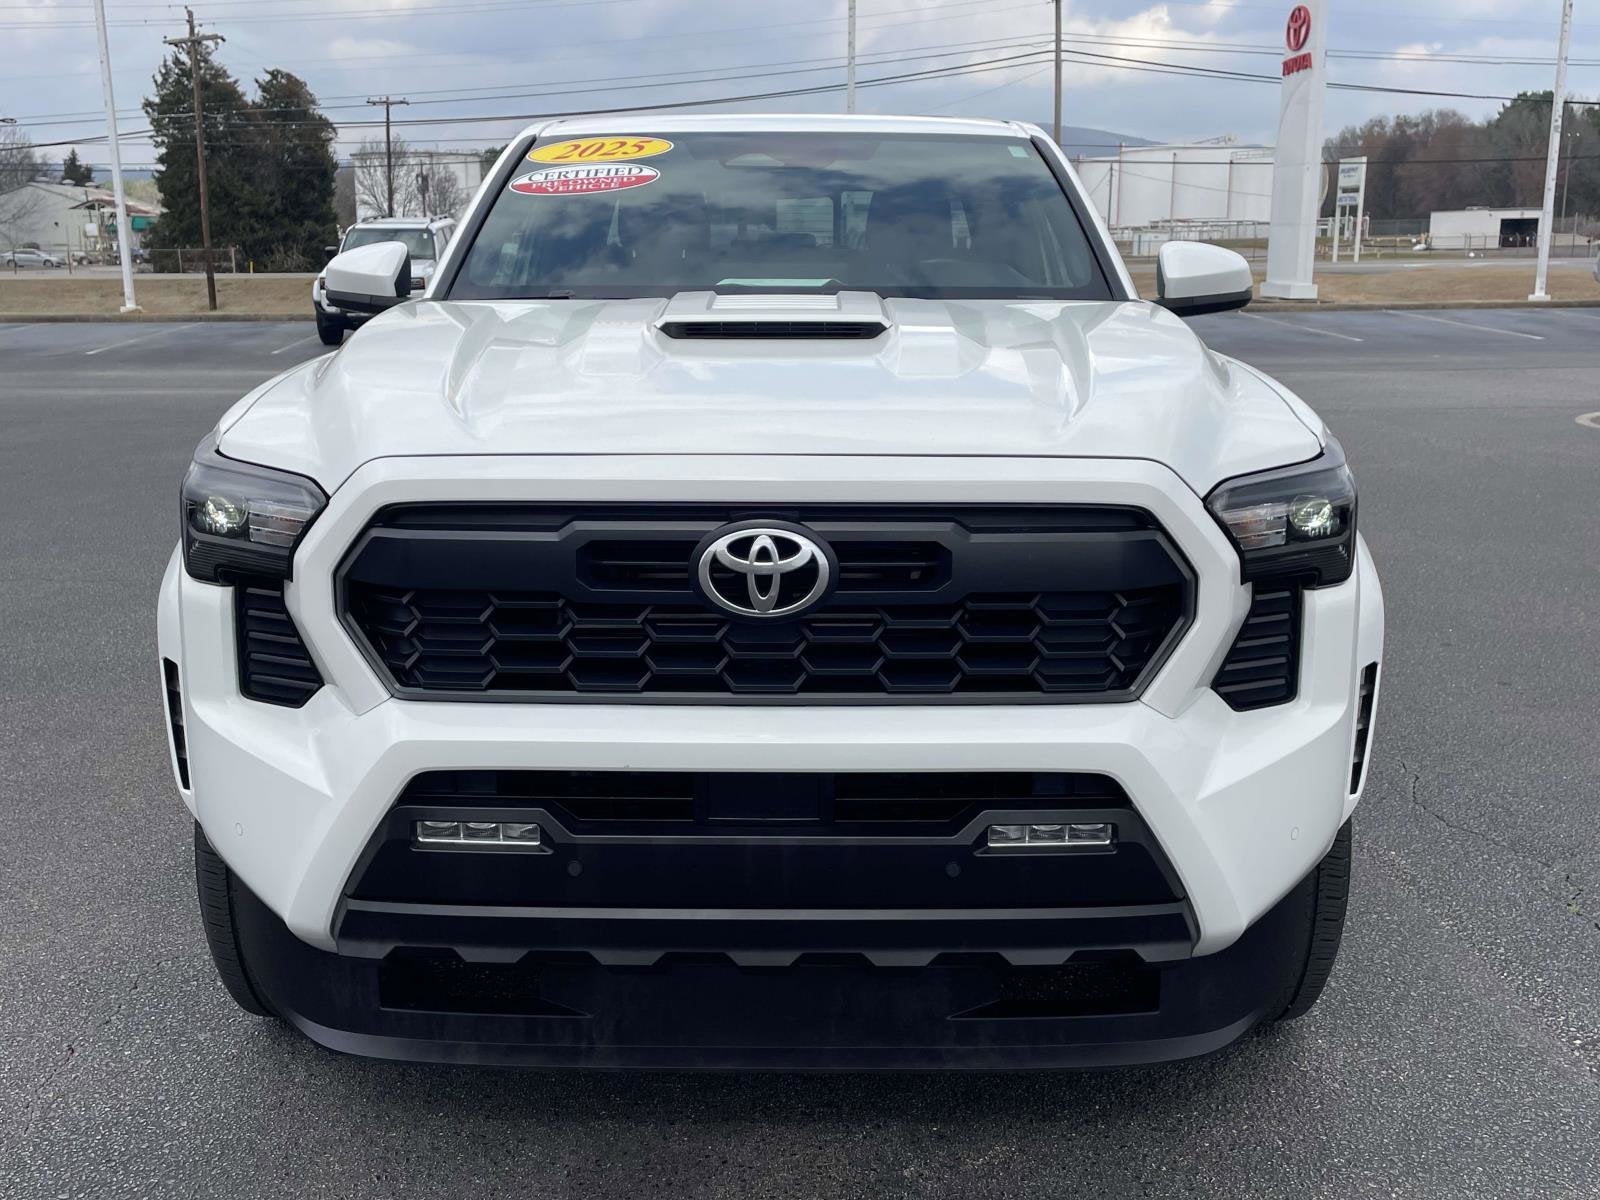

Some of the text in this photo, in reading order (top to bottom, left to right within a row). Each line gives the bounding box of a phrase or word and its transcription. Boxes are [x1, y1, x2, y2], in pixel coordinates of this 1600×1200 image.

[1282, 52, 1312, 76] TOYOTA
[551, 140, 653, 160] 2025
[528, 167, 644, 183] CERTIFIED
[531, 176, 637, 190] PRE-OWNED
[548, 182, 621, 193] VEHICLE
